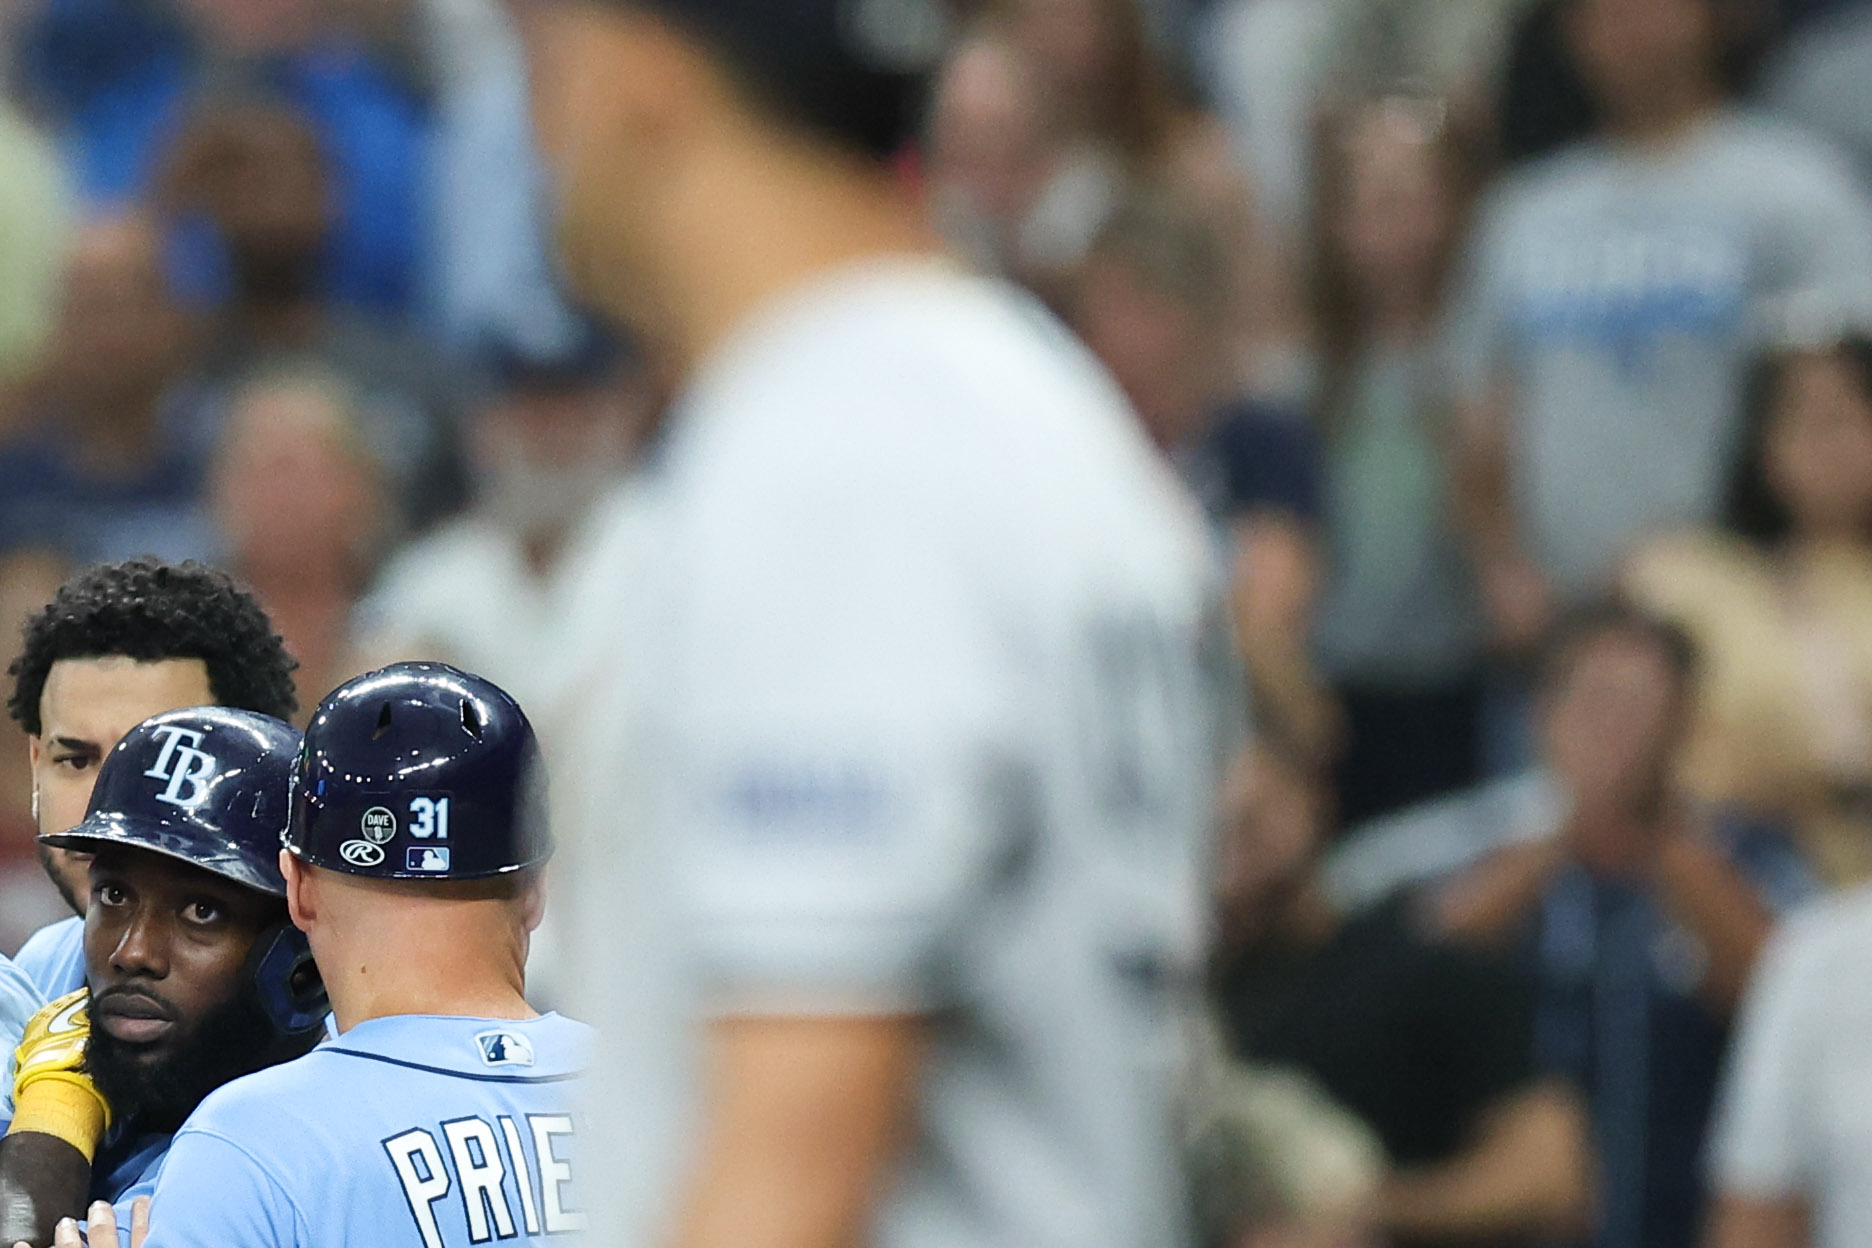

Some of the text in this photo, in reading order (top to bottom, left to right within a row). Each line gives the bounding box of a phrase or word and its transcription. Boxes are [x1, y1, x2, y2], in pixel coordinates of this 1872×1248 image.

[144, 725, 216, 807] TB
[367, 814, 389, 826] DAVE
[409, 796, 449, 839] 31
